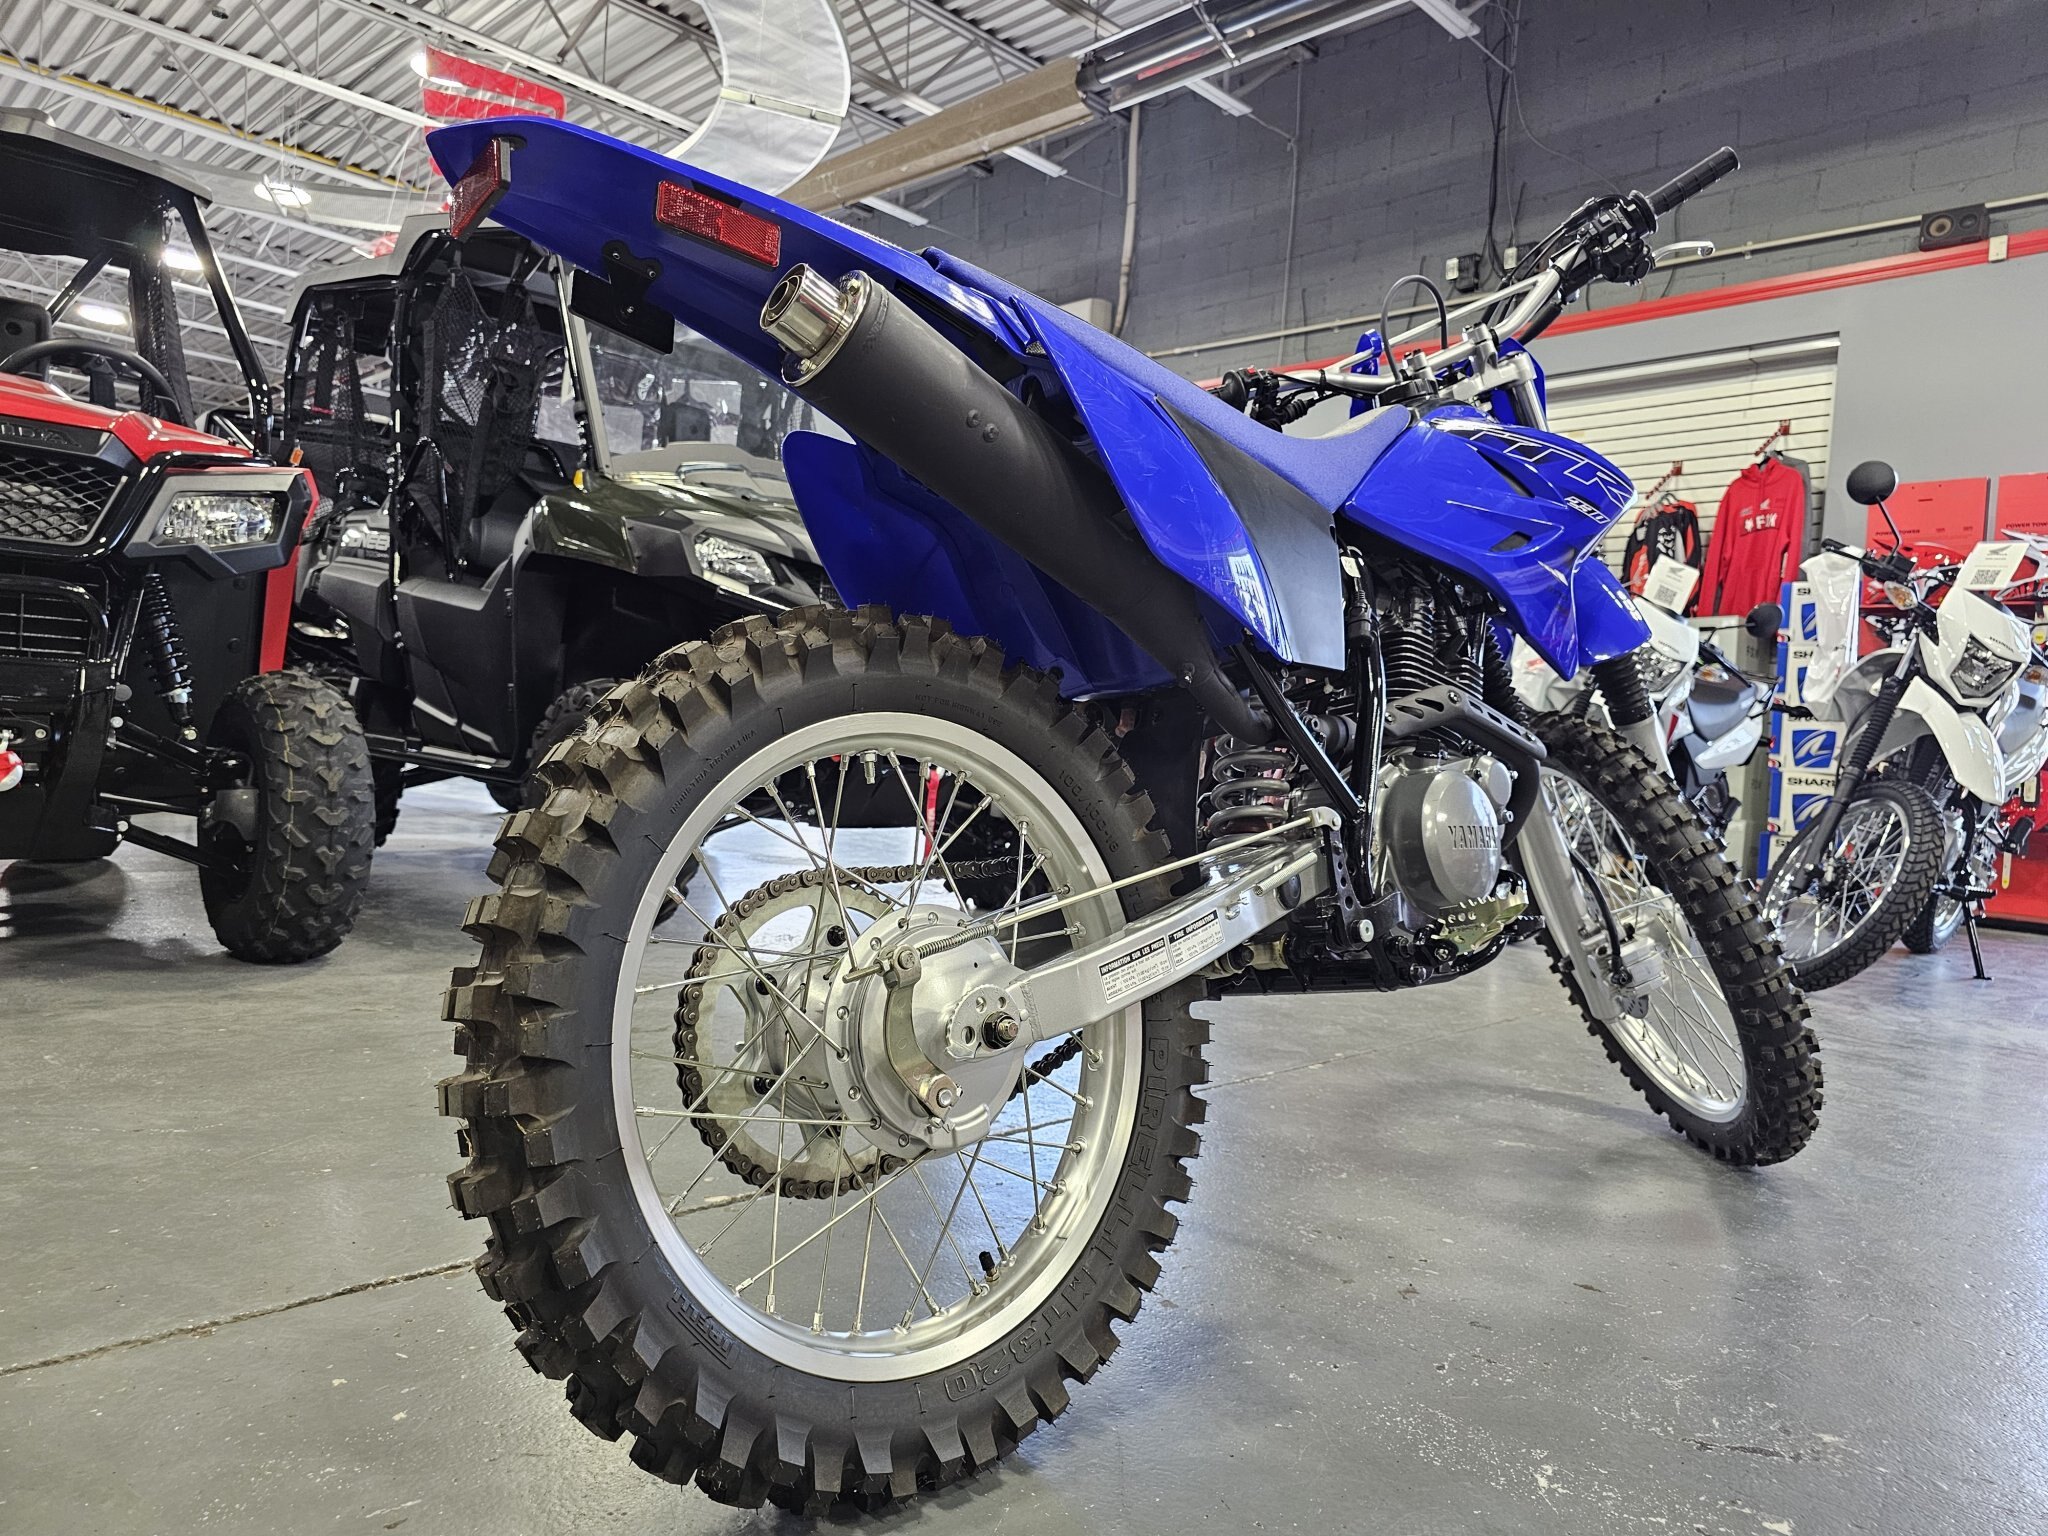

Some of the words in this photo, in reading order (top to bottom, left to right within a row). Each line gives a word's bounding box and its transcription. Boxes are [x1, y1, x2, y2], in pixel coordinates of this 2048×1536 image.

[1448, 825, 1498, 850] YAMAHA
[1100, 956, 1131, 975] INFORMATION
[1131, 951, 1141, 960] SUR
[1142, 945, 1151, 955] LES
[1092, 1036, 1171, 1265] PIRELLI
